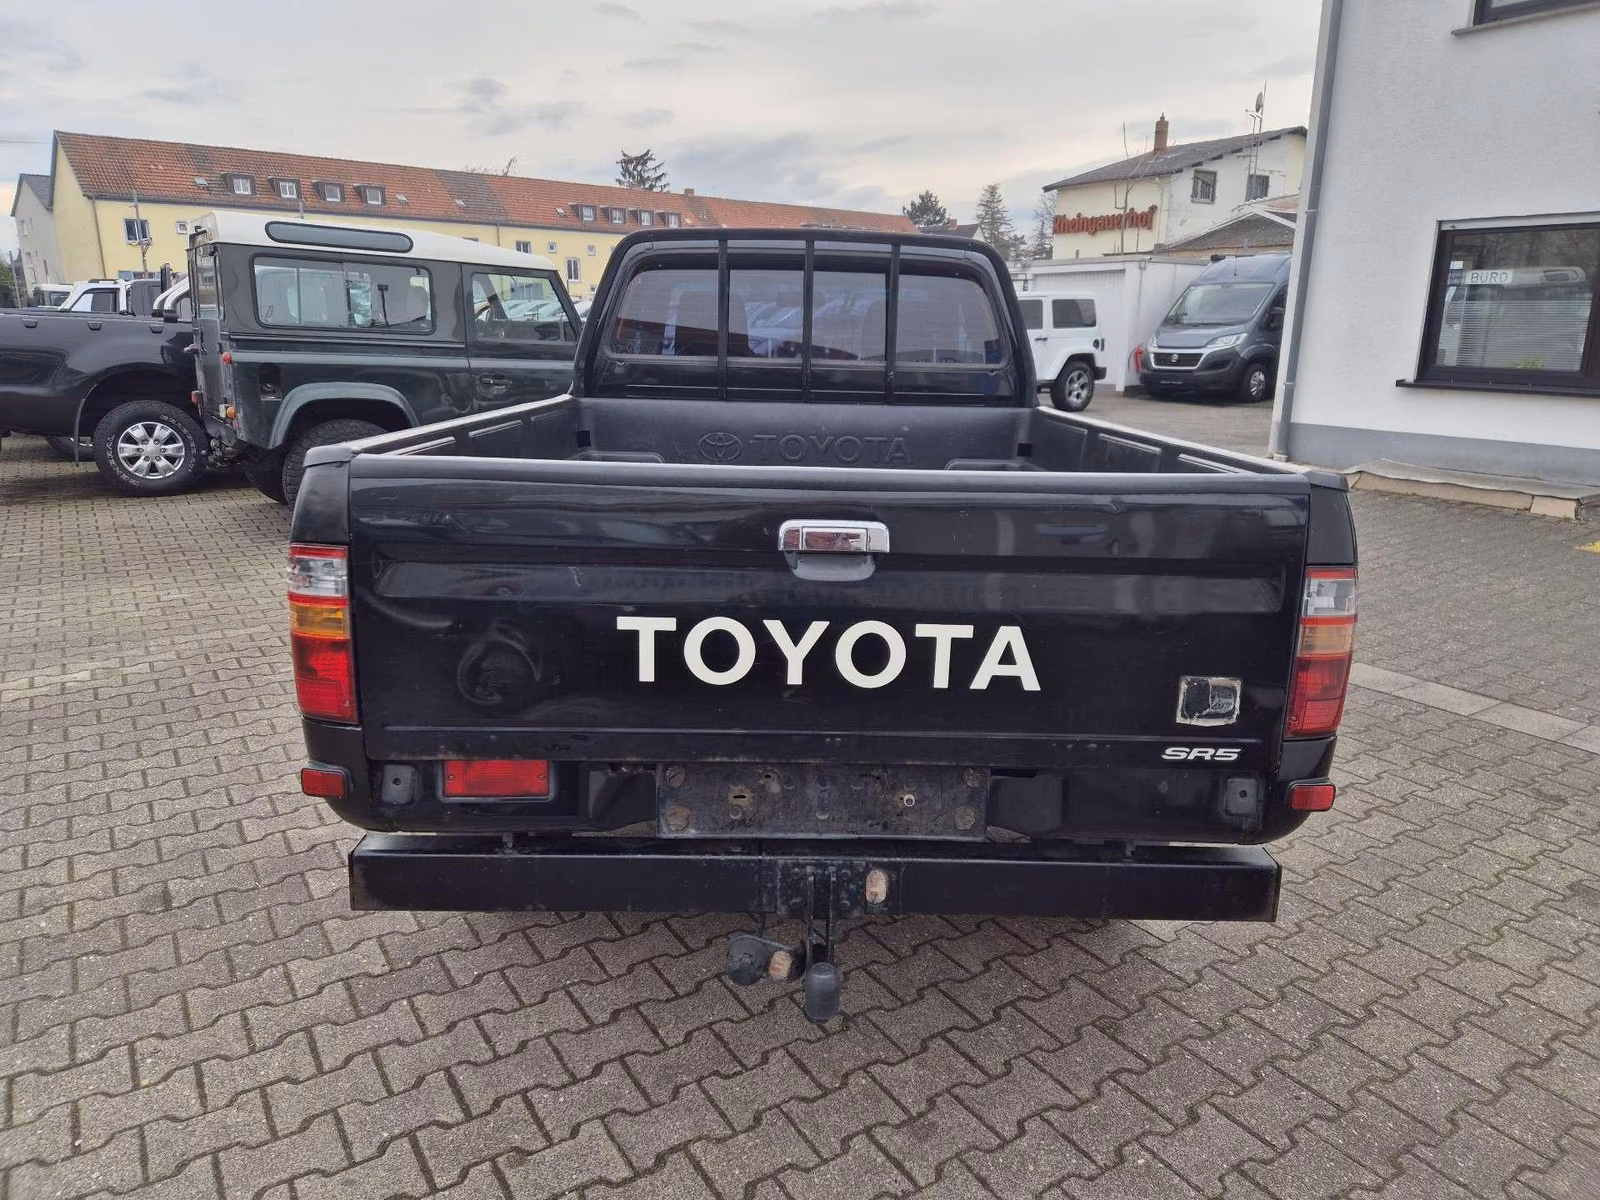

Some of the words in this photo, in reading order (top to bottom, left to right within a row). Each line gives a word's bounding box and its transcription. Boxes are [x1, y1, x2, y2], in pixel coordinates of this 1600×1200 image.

[752, 434, 912, 464] TOYOTA
[616, 616, 1041, 692] TOYOTA
[1161, 747, 1242, 761] SR5
